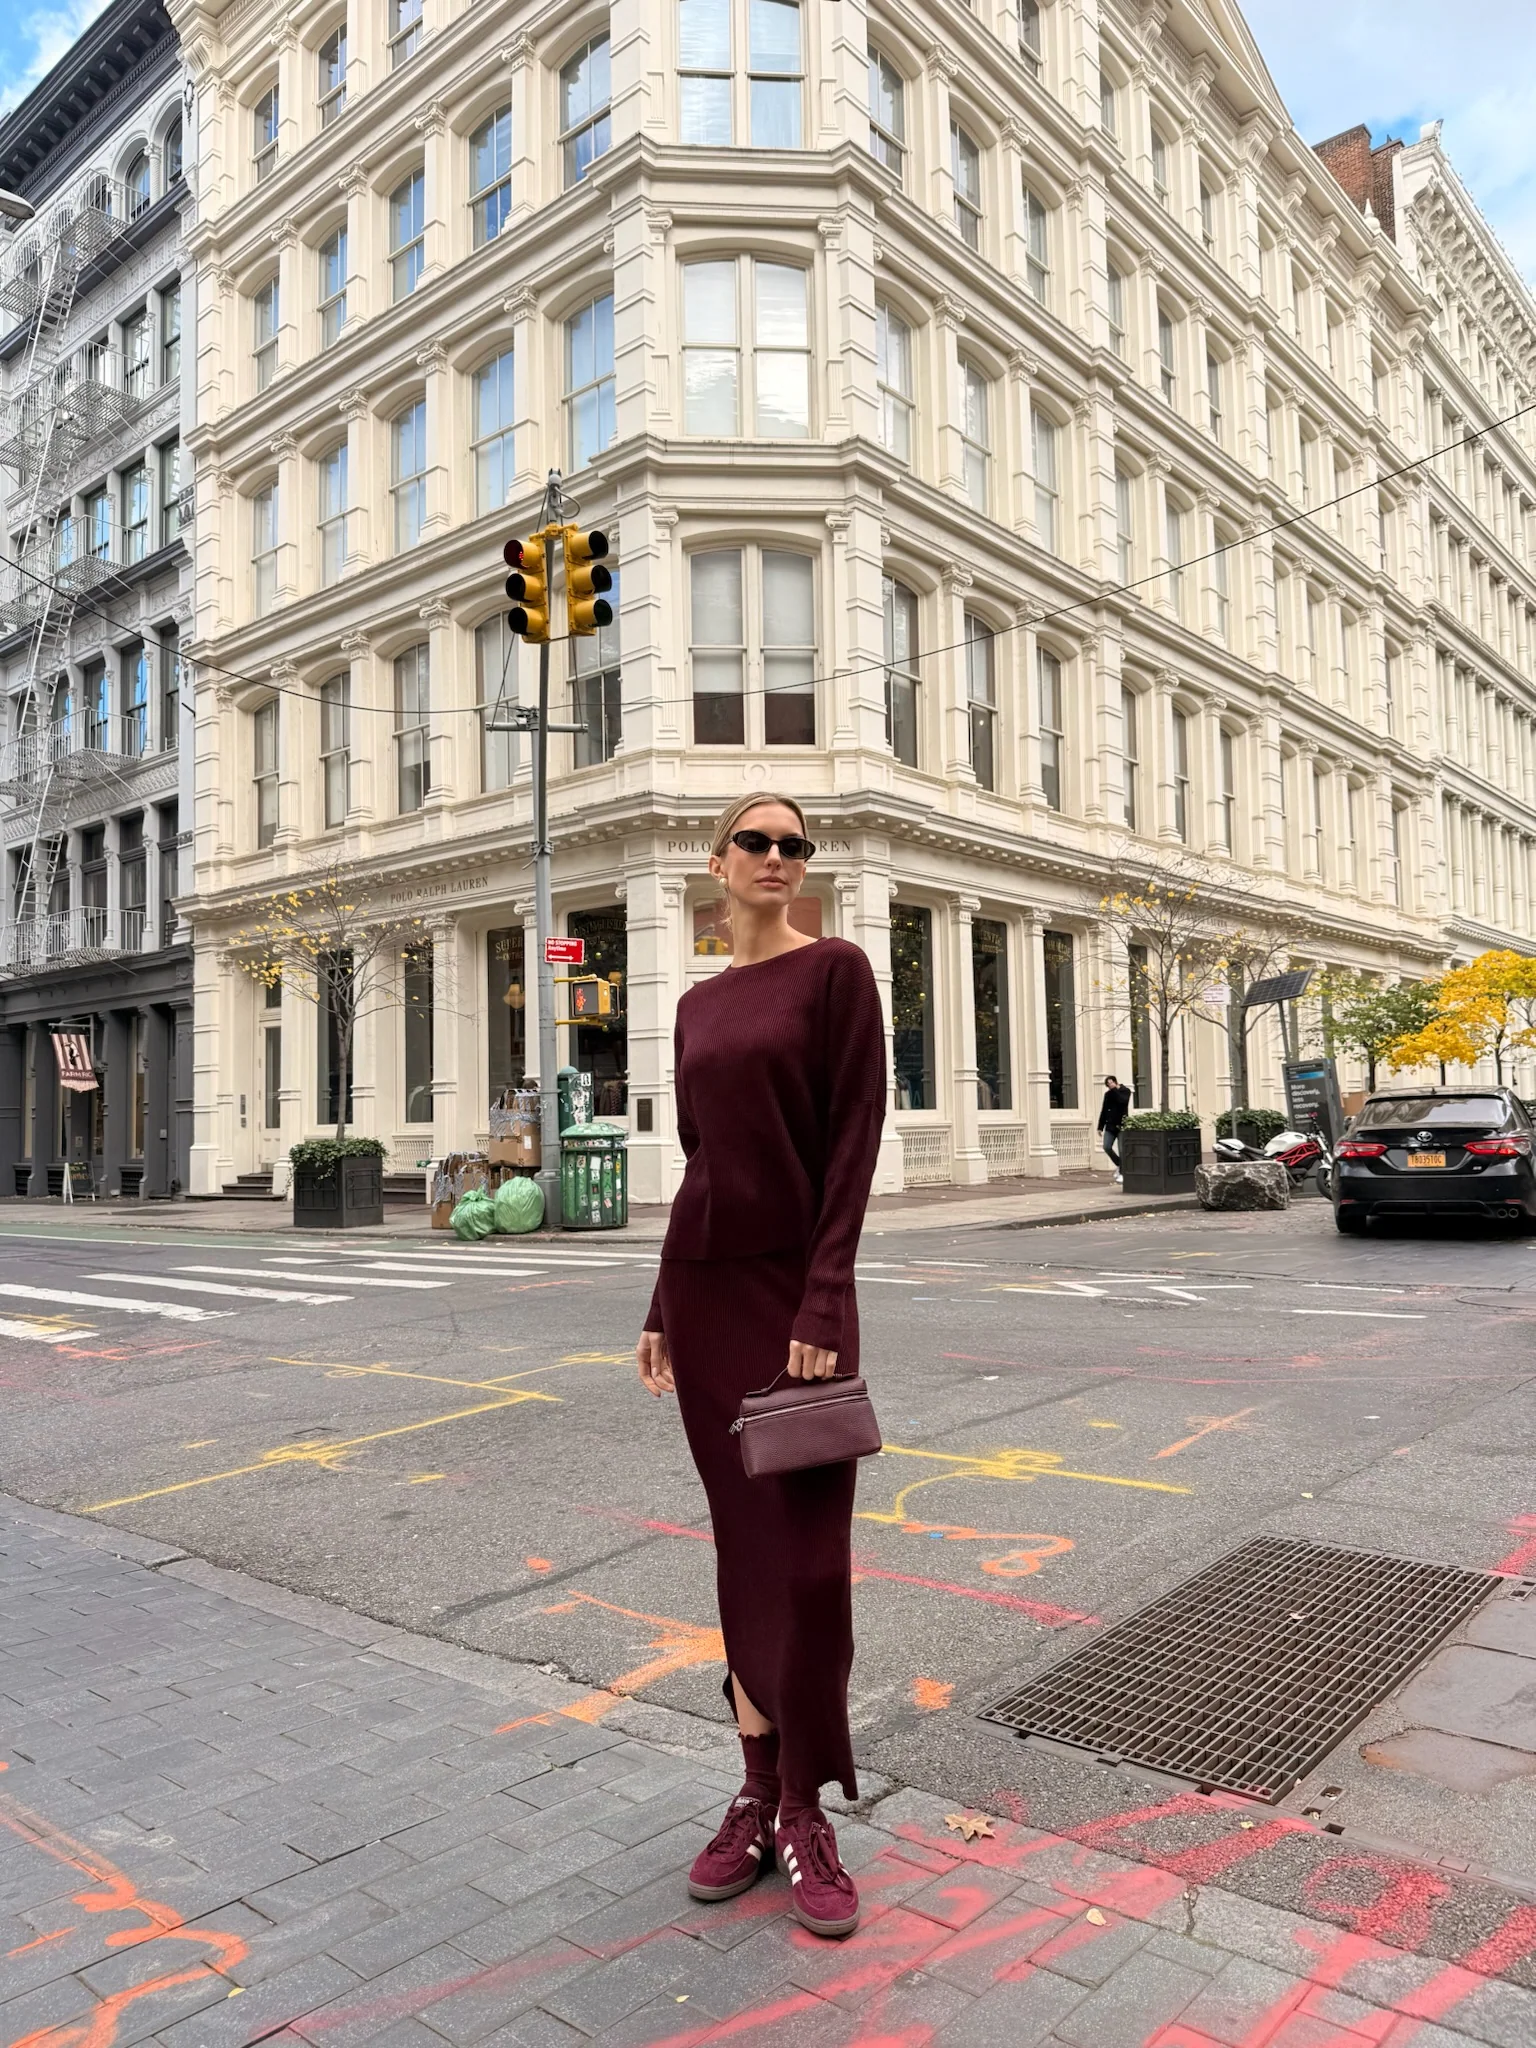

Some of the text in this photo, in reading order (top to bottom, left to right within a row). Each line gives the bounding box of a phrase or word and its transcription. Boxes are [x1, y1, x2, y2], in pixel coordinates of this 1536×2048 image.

[667, 840, 851, 853] POLO REN
[390, 876, 488, 904] POLO RALPH LAUREN
